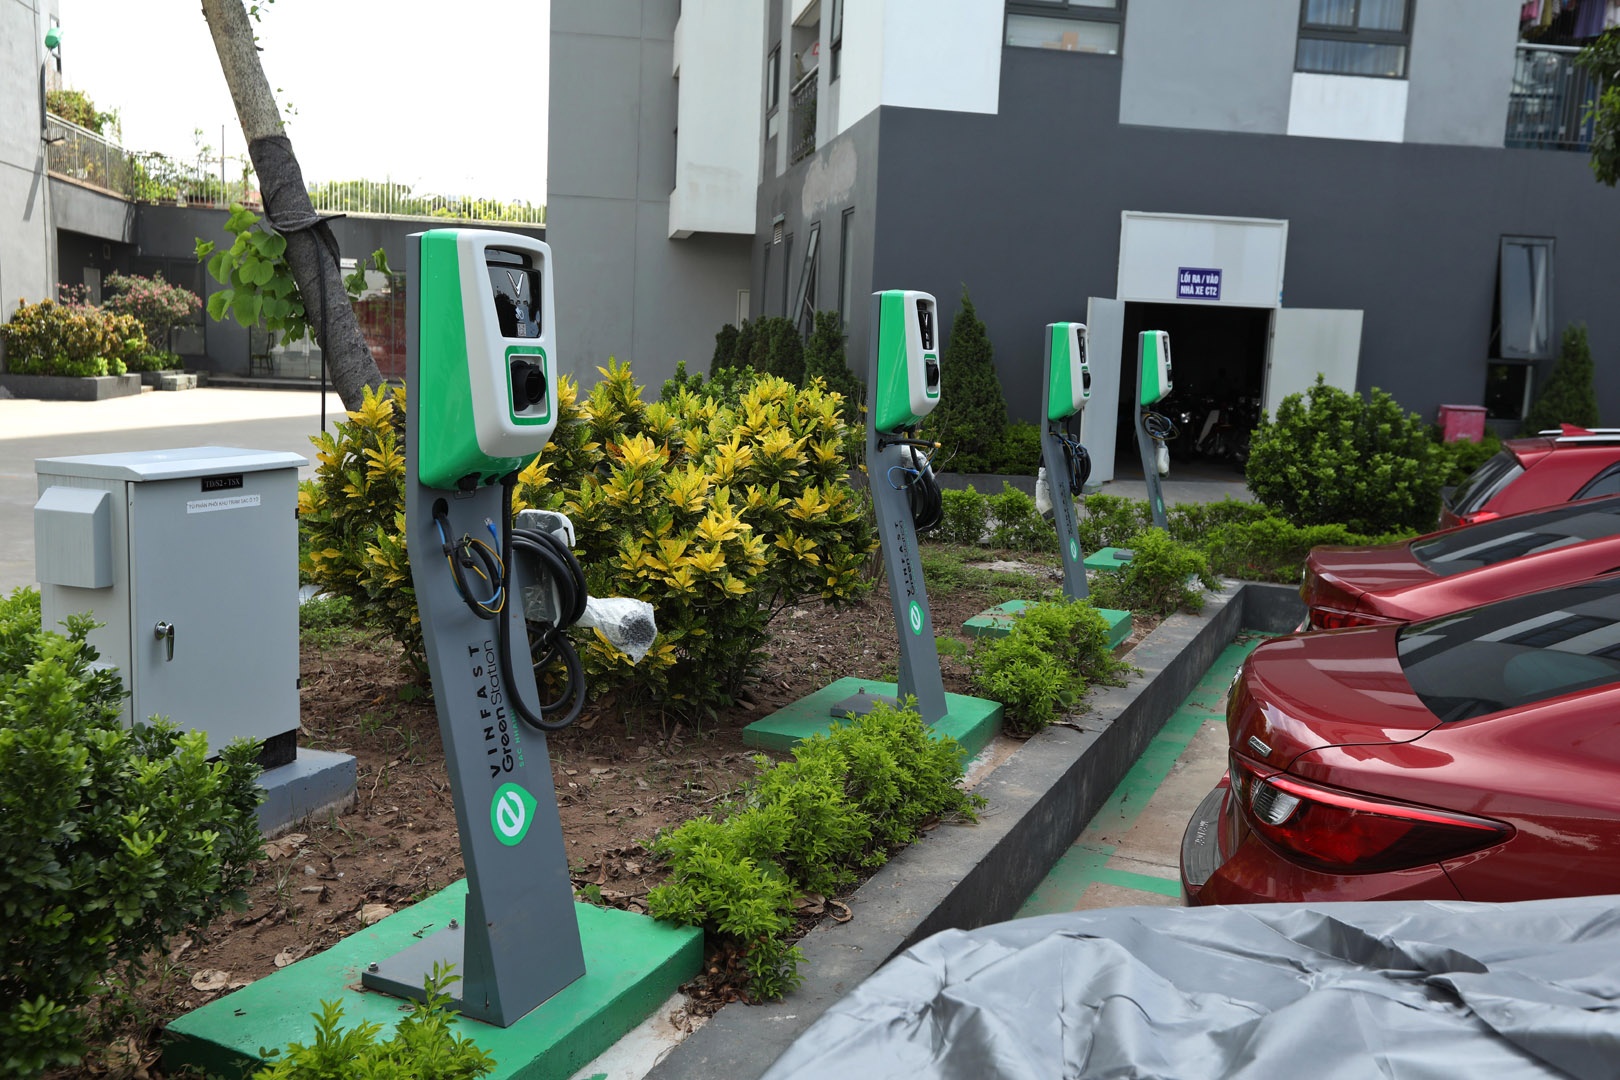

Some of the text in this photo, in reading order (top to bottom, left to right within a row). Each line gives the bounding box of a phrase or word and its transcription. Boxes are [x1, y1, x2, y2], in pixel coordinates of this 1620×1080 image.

[1180, 271, 1191, 283] LỐI
[1192, 274, 1200, 283] RA
[1206, 273, 1219, 284] VÀO
[1180, 283, 1218, 296] NHÀ XE CT2
[468, 645, 501, 779] VINFAST
